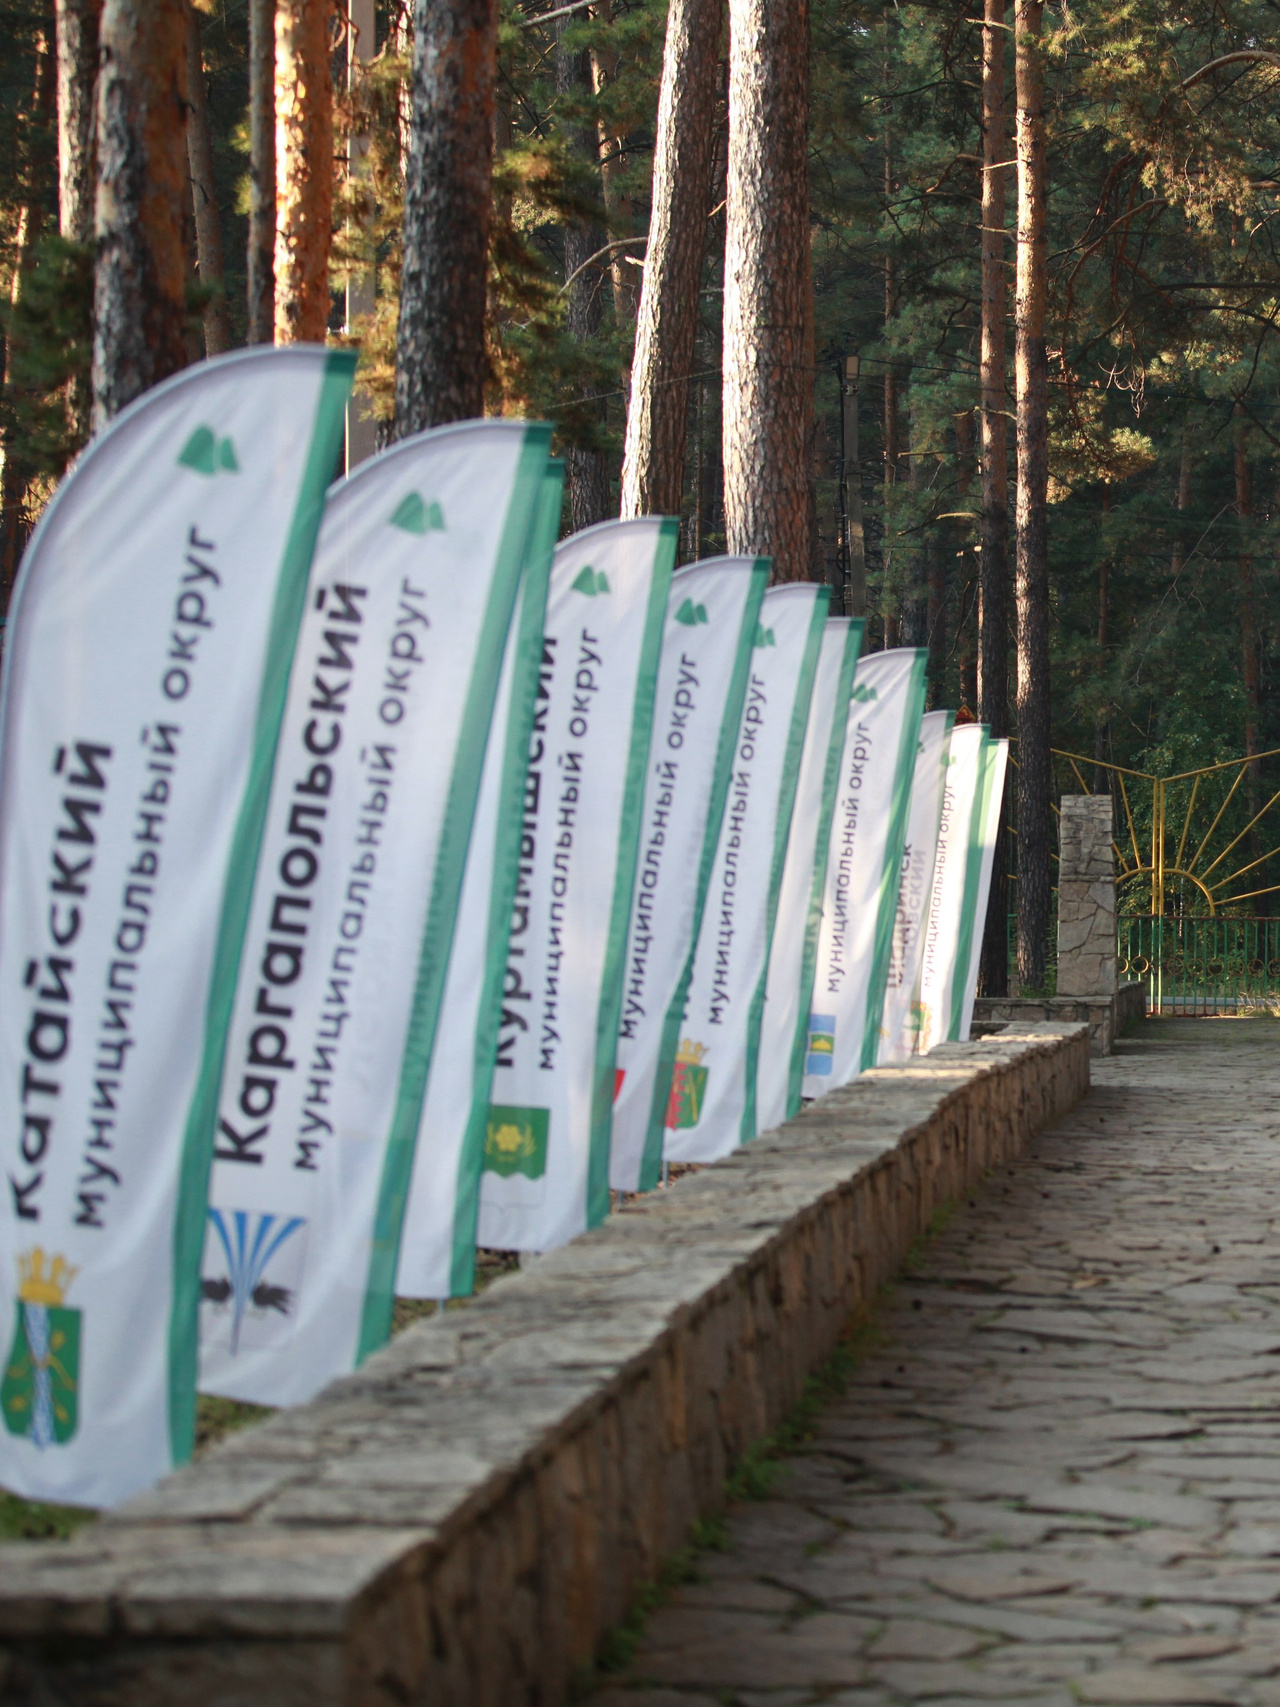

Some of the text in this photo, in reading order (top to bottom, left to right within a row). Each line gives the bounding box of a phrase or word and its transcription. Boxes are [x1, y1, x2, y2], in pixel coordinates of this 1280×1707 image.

[8, 739, 113, 1222] Катайский
[73, 523, 220, 1230] муниципальный округ
[212, 581, 369, 1166] Каргапольский
[293, 577, 431, 1171] муниципальный округ
[538, 627, 603, 1072] муниципальный округ
[618, 760, 679, 1040] муниципальный
[667, 653, 700, 750] округ
[709, 674, 768, 1026] муниципальный округ
[827, 722, 873, 994] муниципальный округ
[923, 838, 948, 988] муниципальный
